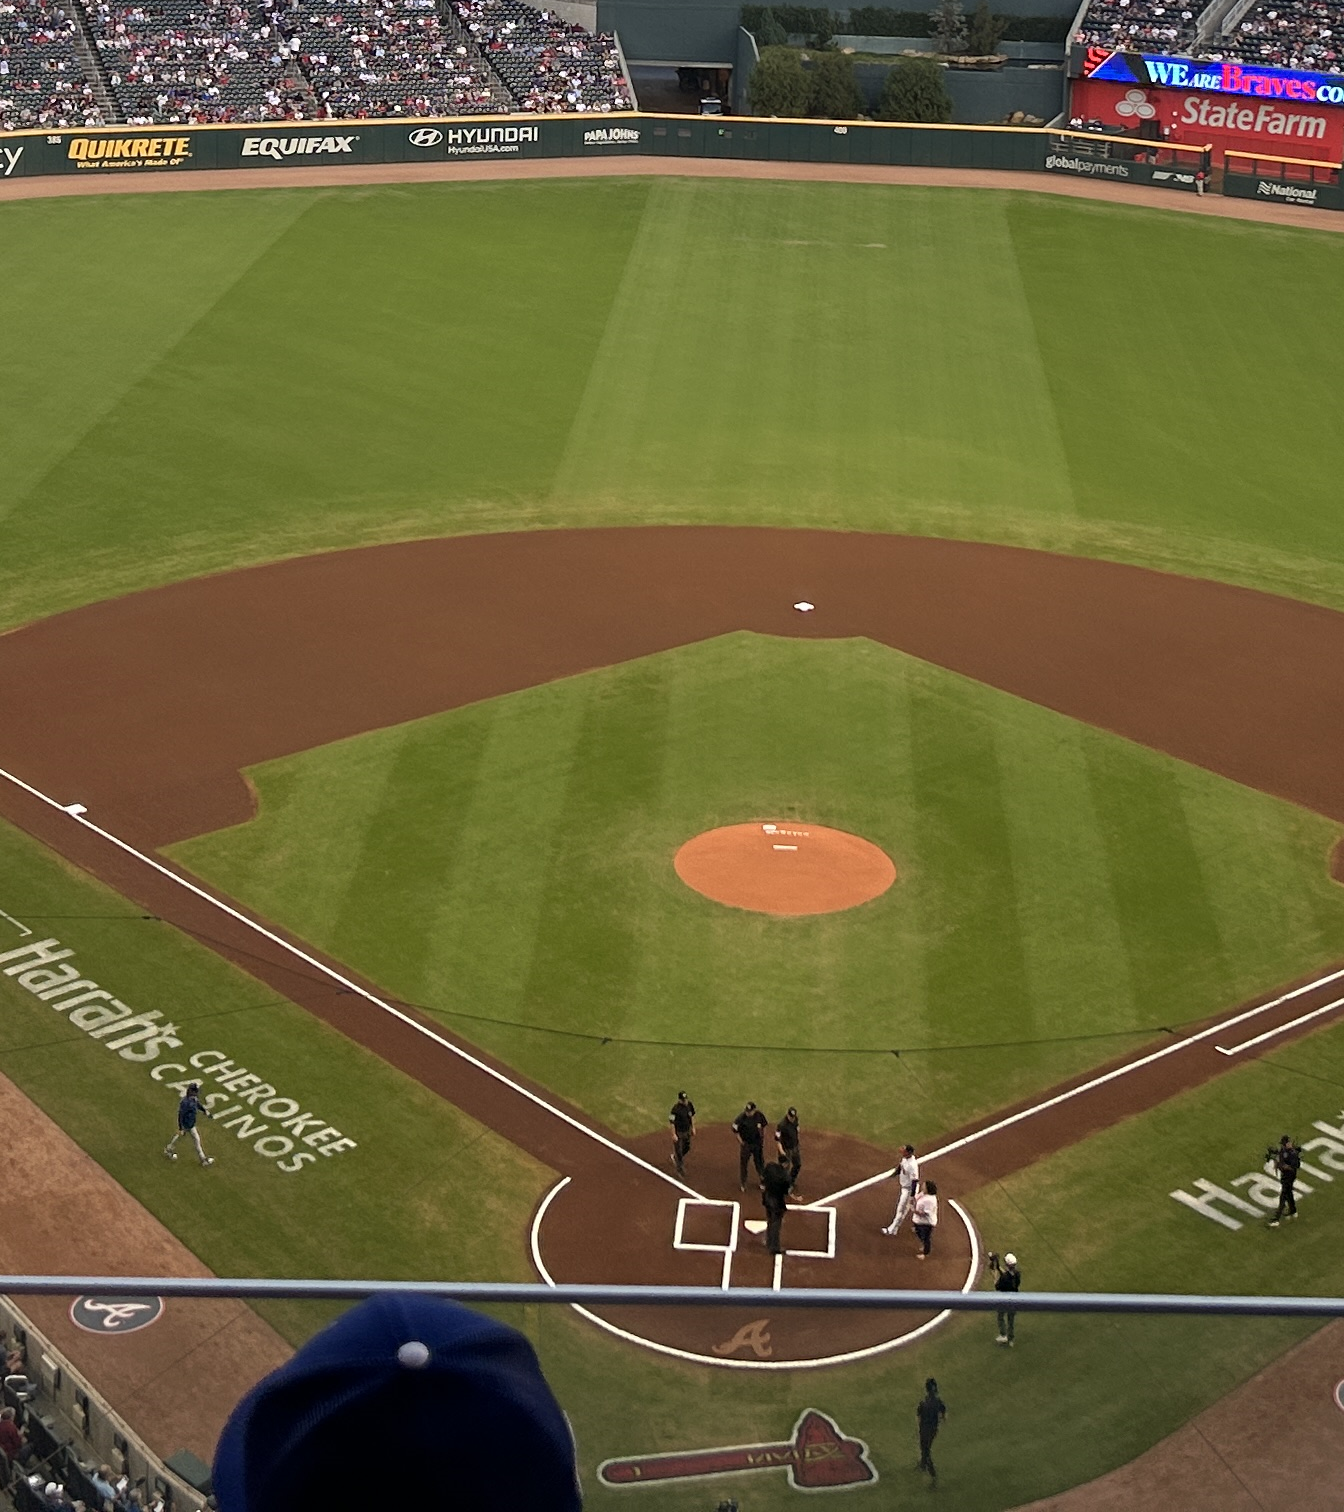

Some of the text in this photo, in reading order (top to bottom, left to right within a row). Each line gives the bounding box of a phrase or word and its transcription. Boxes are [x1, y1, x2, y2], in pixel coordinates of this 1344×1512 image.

[1146, 60, 1190, 86] WE
[1189, 73, 1221, 90] ARE
[1221, 63, 1316, 100] Braves
[47, 136, 62, 145] 385
[448, 127, 538, 143] HYUNDAI
[68, 137, 191, 160] QUIKRETE
[242, 136, 358, 160] EQUIFAX
[448, 144, 519, 154] HyundaiUSA.com
[1046, 155, 1128, 177] globalpayments
[1270, 183, 1316, 200] National
[189, 1050, 358, 1157] CHEROKEE
[150, 1063, 316, 1172] CASINOS
